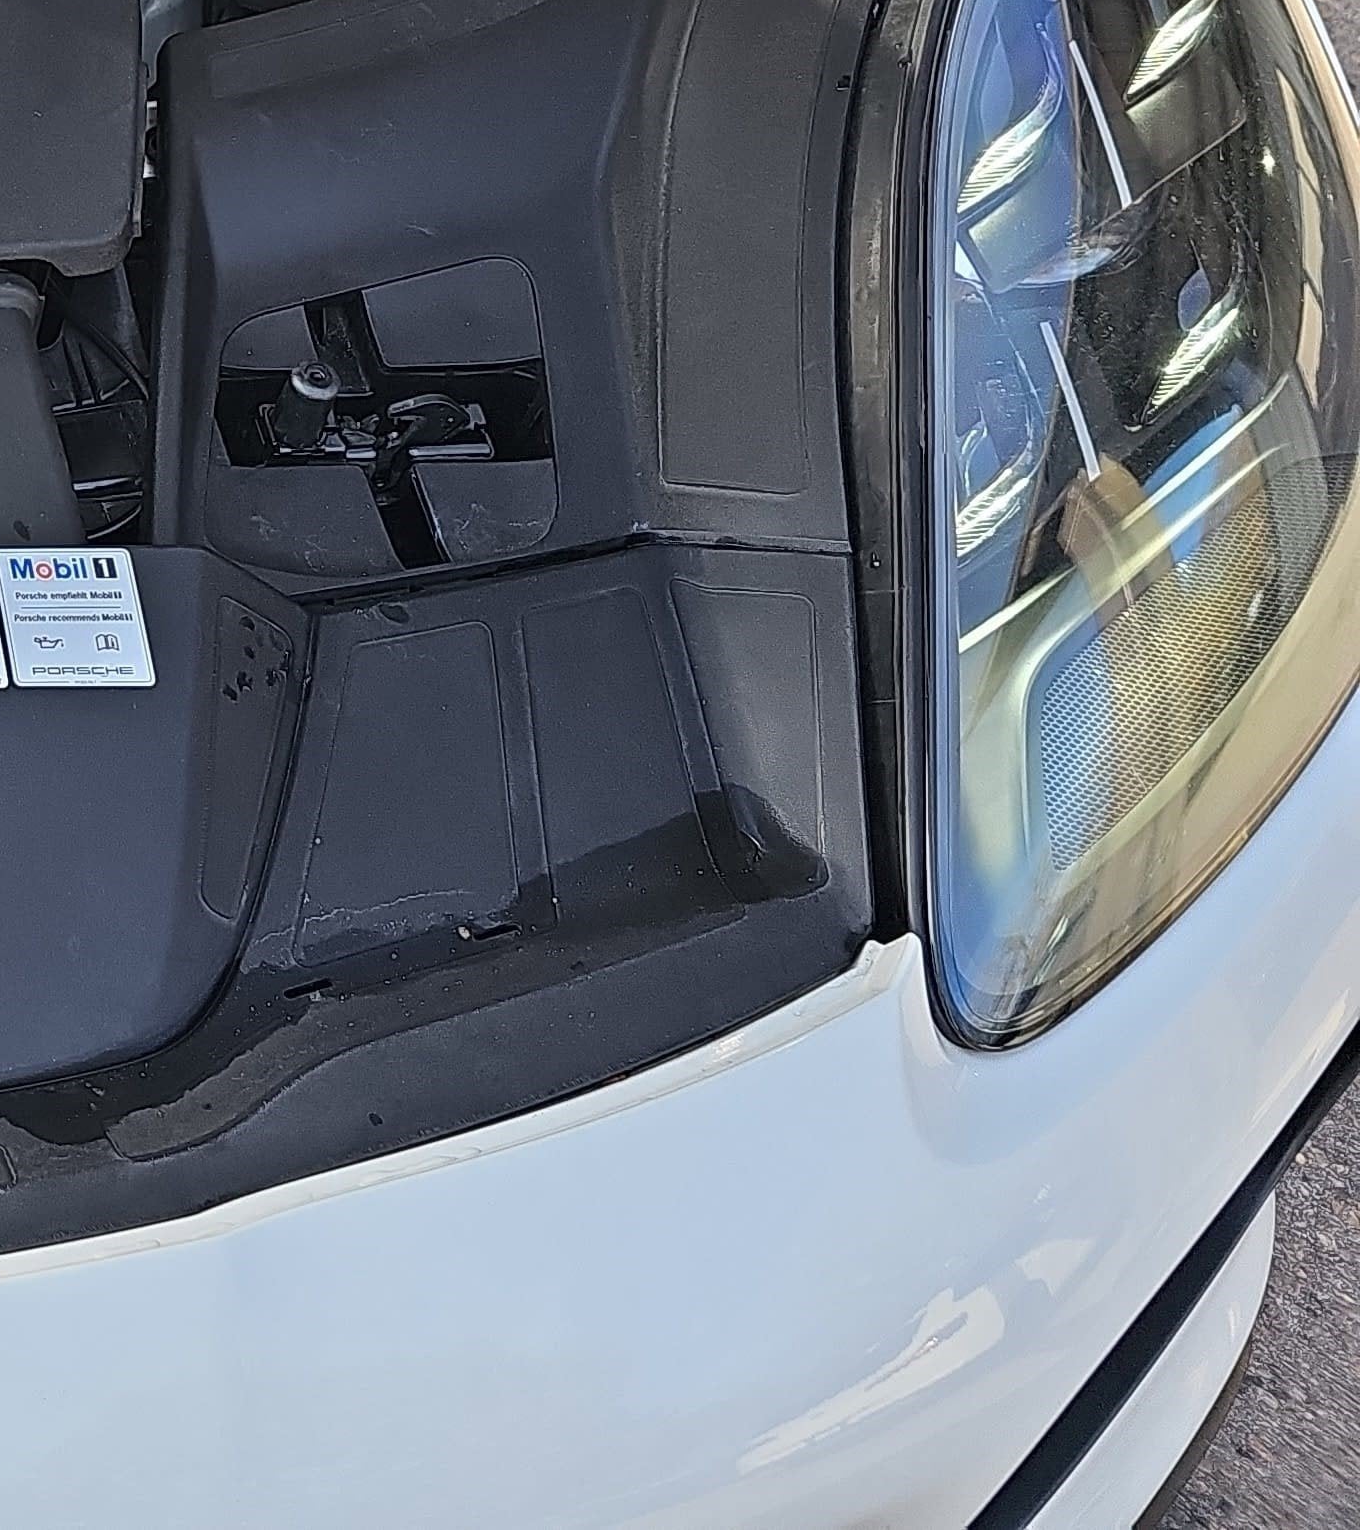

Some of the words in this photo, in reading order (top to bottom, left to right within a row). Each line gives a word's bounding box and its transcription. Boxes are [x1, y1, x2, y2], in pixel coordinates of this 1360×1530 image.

[9, 557, 88, 579] Mobil
[93, 558, 117, 579] 1
[15, 591, 48, 600] Porsche
[50, 591, 88, 601] empfiehlt
[90, 591, 113, 599] Mobil
[14, 613, 47, 622] Porsche
[48, 613, 100, 622] recommends
[101, 613, 125, 621] Mobil
[32, 666, 135, 676] PORSCHE
